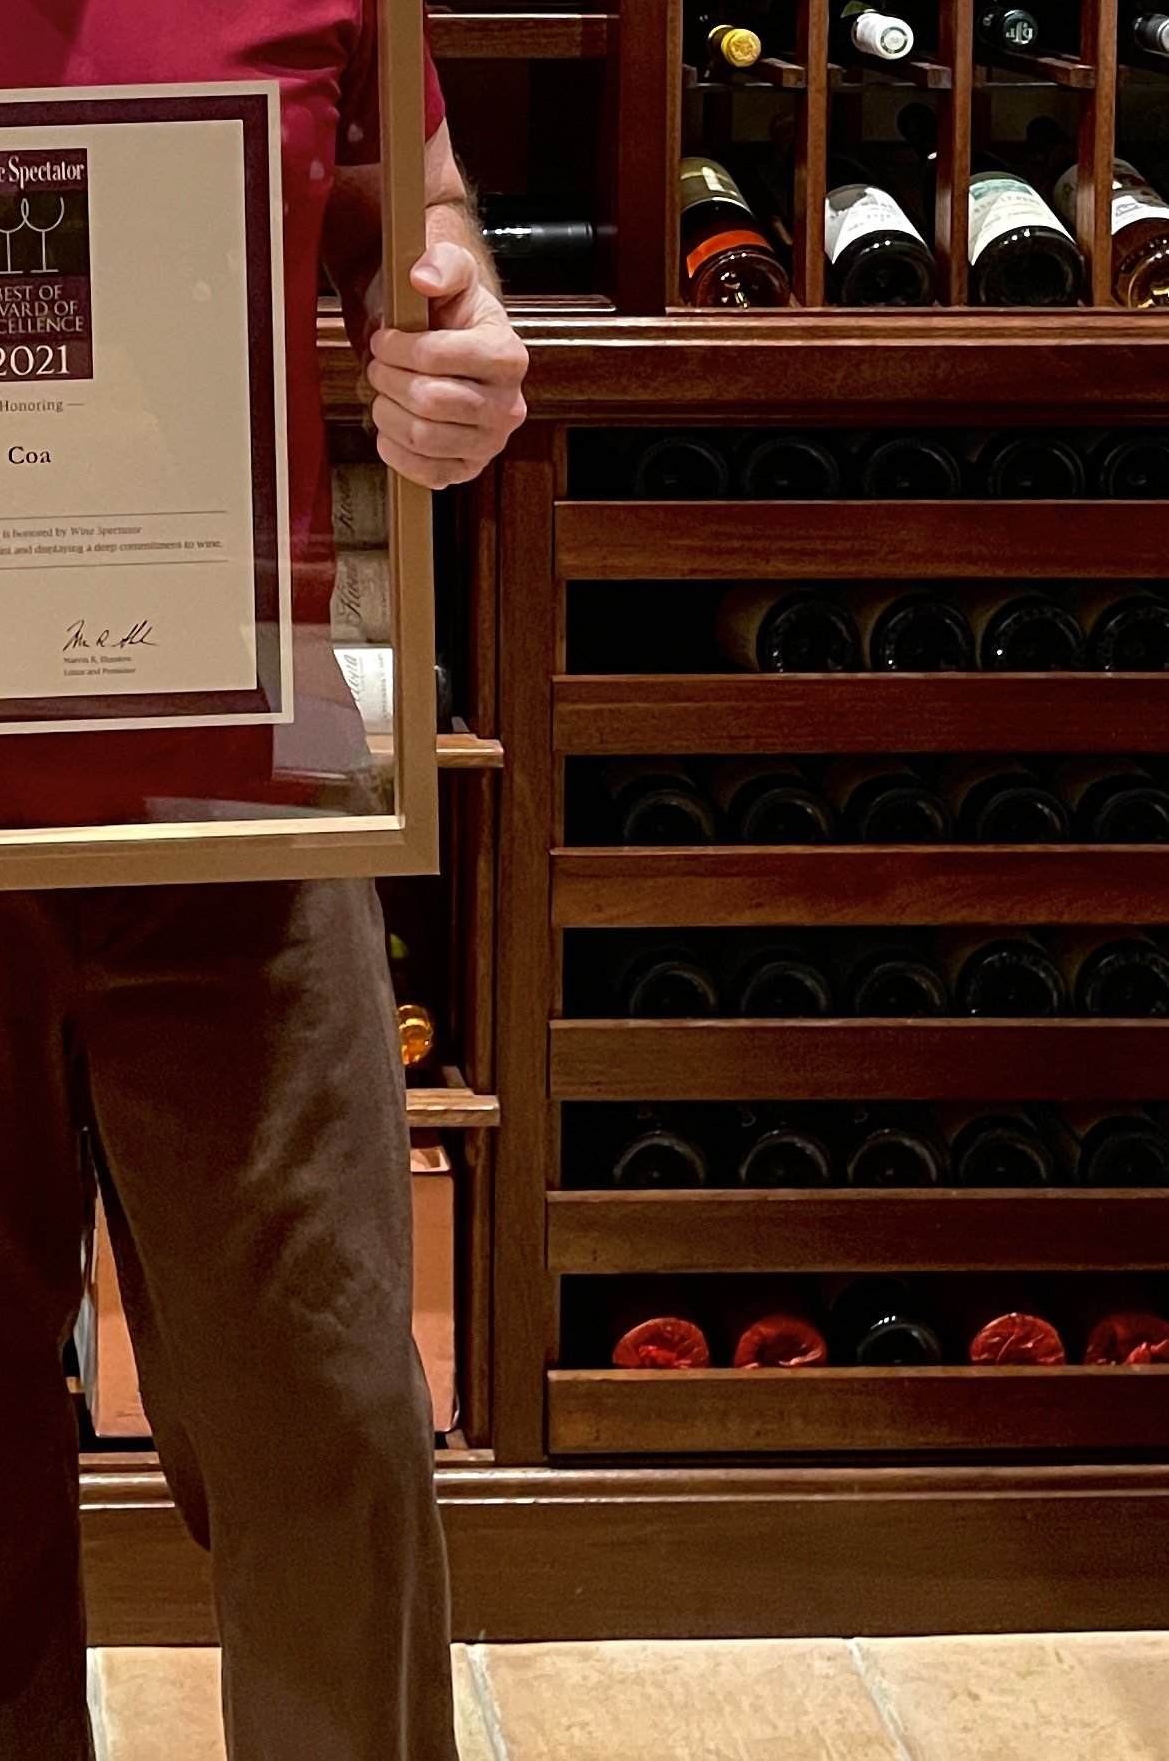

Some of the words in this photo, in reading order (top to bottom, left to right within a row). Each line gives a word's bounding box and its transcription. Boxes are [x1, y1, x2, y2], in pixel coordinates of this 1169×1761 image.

[8, 155, 85, 189] Spectator
[38, 284, 63, 301] OF
[54, 300, 79, 316] OF
[7, 445, 52, 465] Coa
[2, 530, 11, 539] is
[13, 528, 53, 538] honored
[56, 527, 67, 538] by
[70, 526, 95, 536] Wine
[14, 545, 33, 555] and
[34, 544, 84, 555] displaying
[94, 542, 118, 553] deep
[119, 541, 182, 551] commitment
[184, 540, 194, 549] to
[196, 539, 224, 548] wine.
